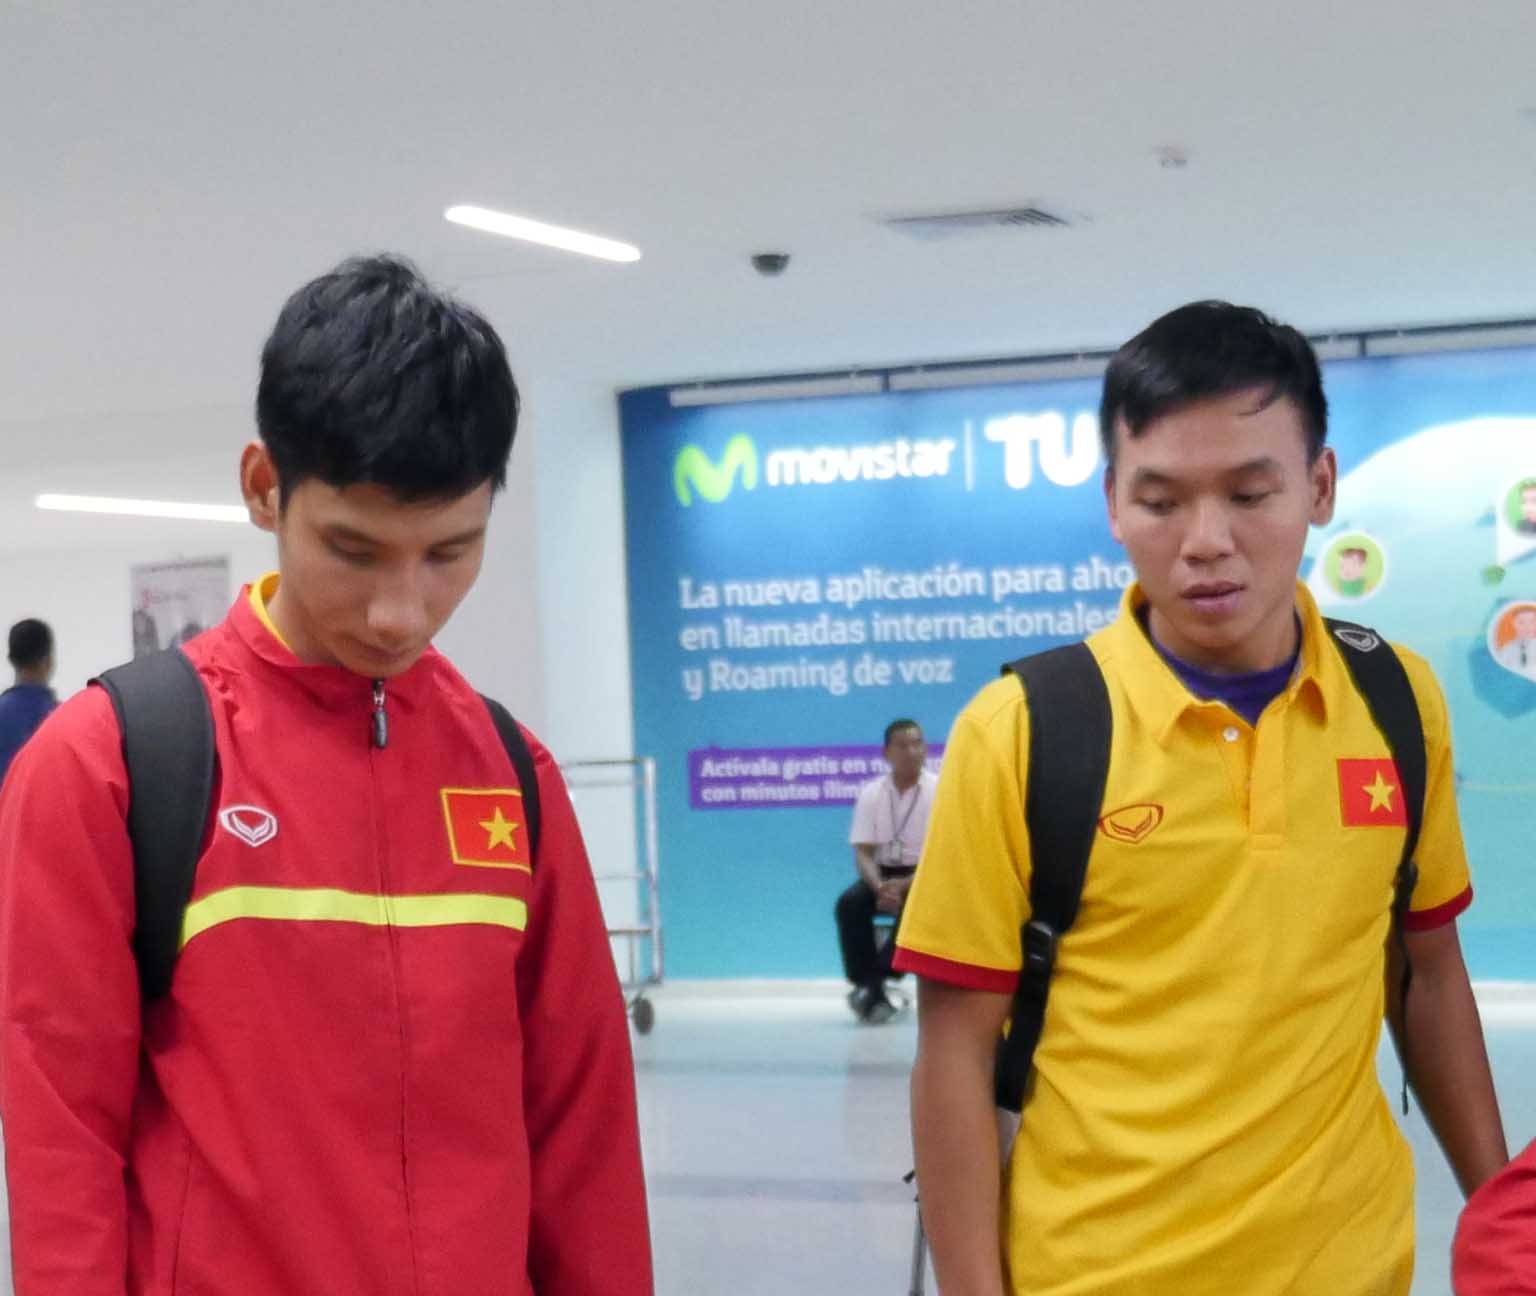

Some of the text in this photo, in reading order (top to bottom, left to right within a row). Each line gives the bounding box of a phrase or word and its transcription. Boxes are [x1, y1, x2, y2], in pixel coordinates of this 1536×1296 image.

[766, 411, 1100, 490] movistar TU
[679, 577, 719, 608] La
[722, 579, 821, 606] nueva
[825, 562, 986, 609] aplicación
[991, 565, 1064, 603] para
[680, 624, 720, 651] en
[723, 611, 867, 649] llamadas
[683, 652, 953, 700] y Roaming de voz
[701, 783, 737, 803] con
